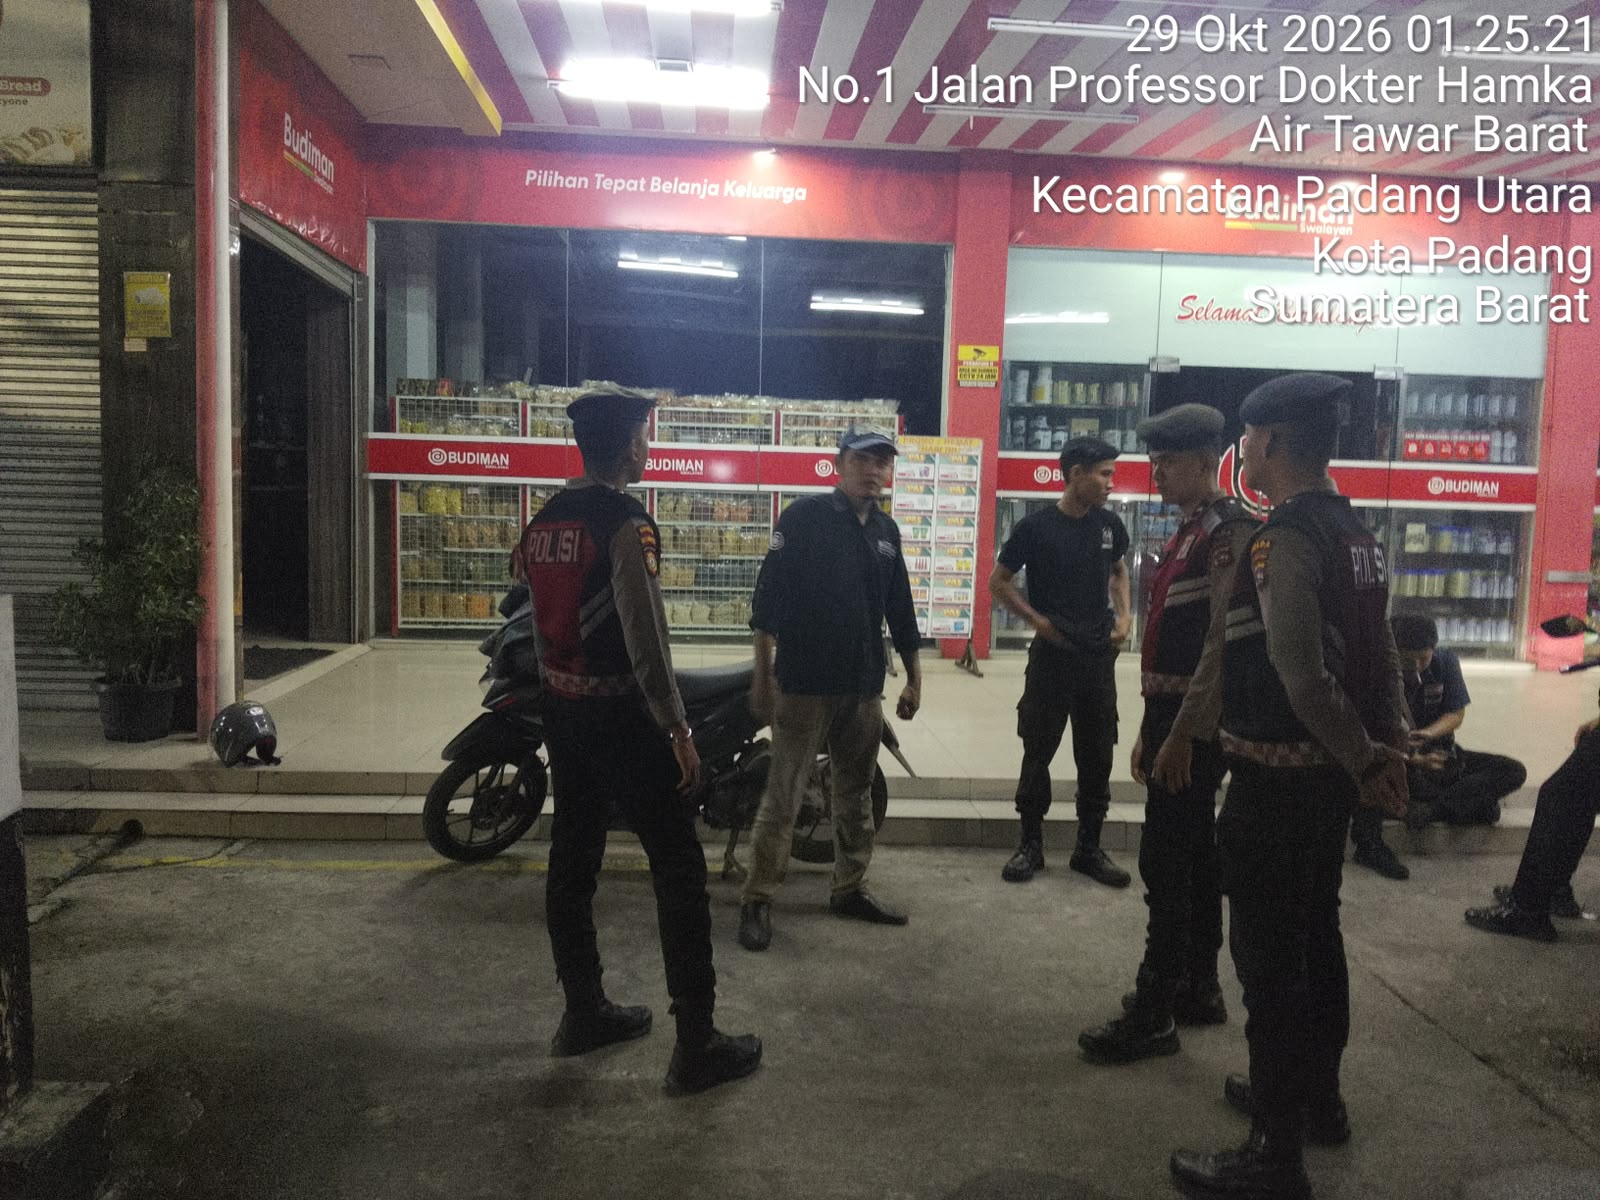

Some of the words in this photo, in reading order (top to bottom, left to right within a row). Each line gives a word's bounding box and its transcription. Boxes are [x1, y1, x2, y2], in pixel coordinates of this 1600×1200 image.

[283, 112, 335, 183] Budiman
[525, 170, 589, 189] Pilihan
[595, 174, 646, 193] Tepat
[650, 176, 720, 199] Belanja
[723, 180, 807, 204] Keluarga
[1300, 223, 1353, 236] Swalayan
[448, 451, 509, 466] BUDIMAN
[645, 458, 704, 472] BUDIMAN
[1445, 479, 1499, 496] BUDIMAN
[528, 529, 582, 564] POLISI
[1350, 546, 1388, 584] POLSI
